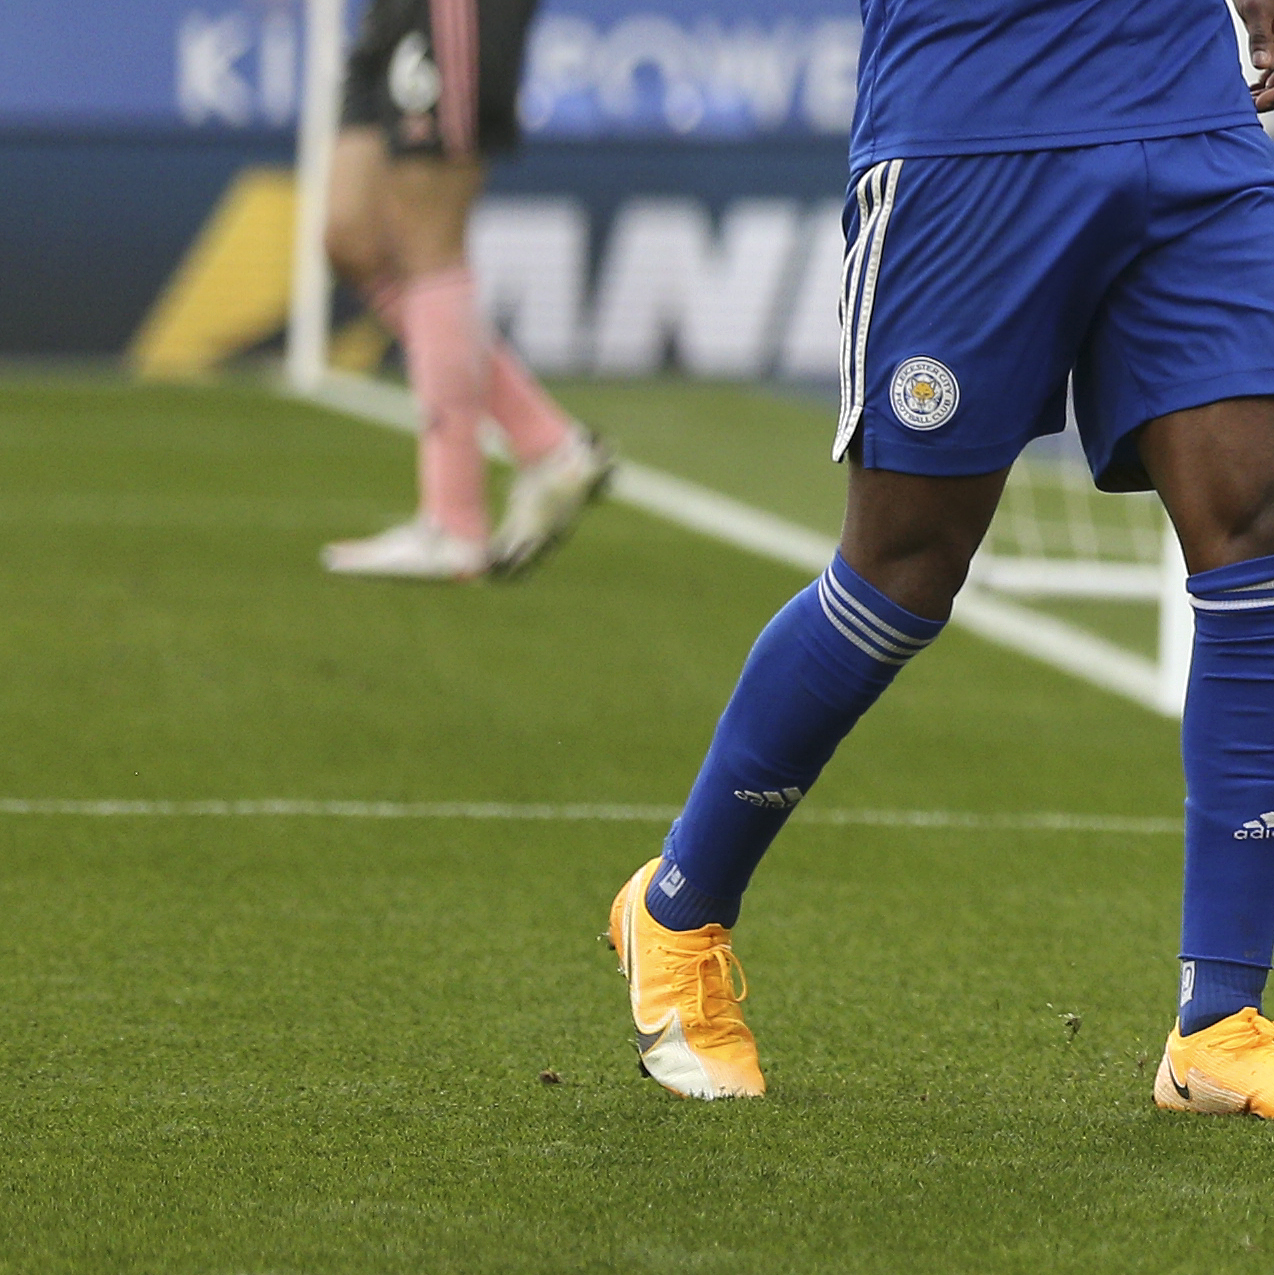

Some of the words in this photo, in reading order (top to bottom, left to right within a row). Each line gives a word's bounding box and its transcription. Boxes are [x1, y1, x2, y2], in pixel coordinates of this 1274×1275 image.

[388, 30, 441, 113] 6
[896, 364, 939, 388] LEICESTER
[939, 374, 954, 395] CITY
[895, 392, 931, 423] FOOTBALL
[931, 399, 952, 421] CLUB
